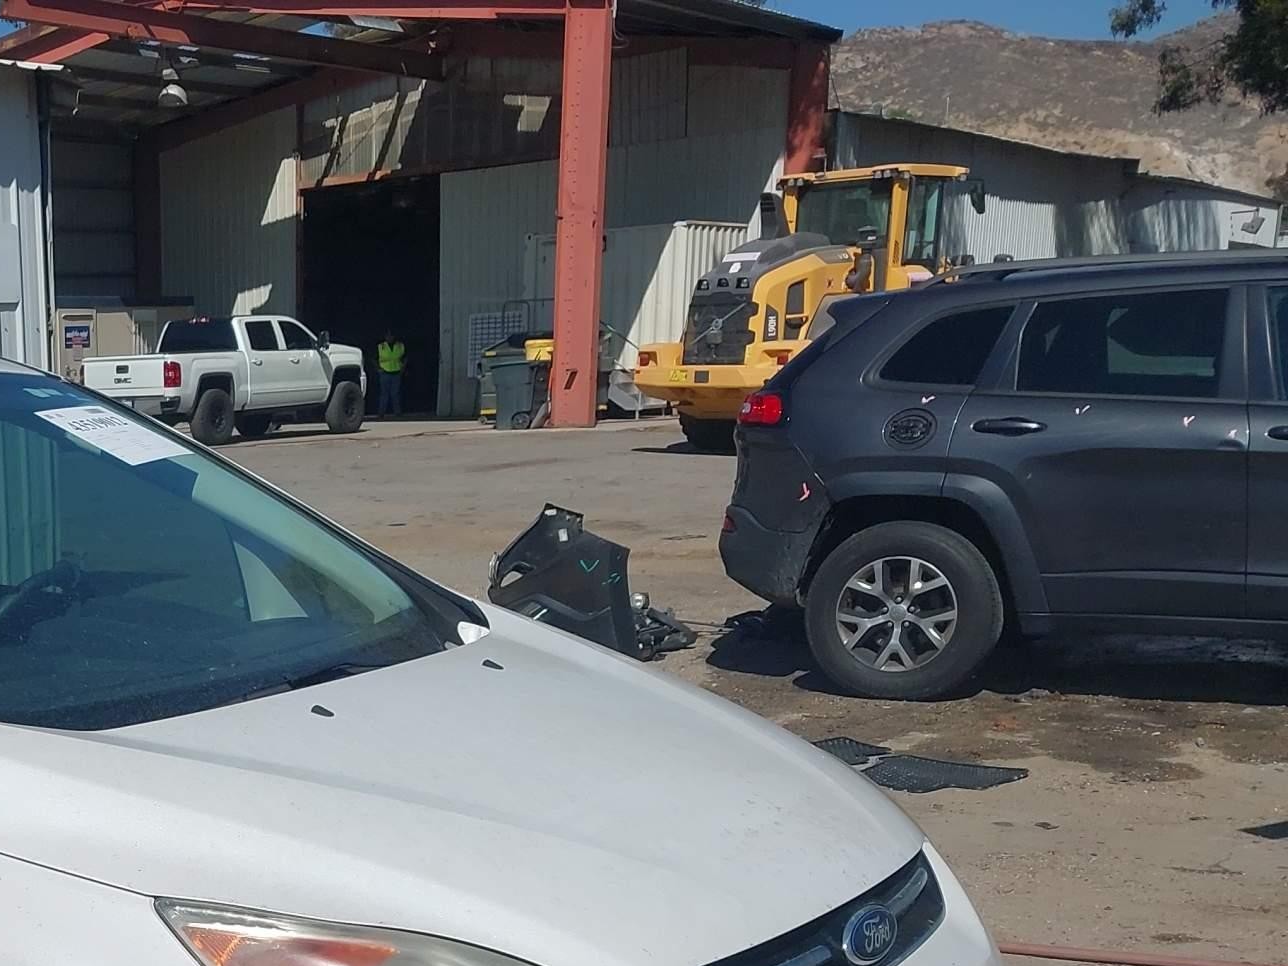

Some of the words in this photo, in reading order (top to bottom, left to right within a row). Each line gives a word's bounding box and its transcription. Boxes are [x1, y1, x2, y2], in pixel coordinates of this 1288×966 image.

[768, 316, 776, 337] L90H
[564, 369, 578, 390] 7
[863, 915, 890, 953] Ford
